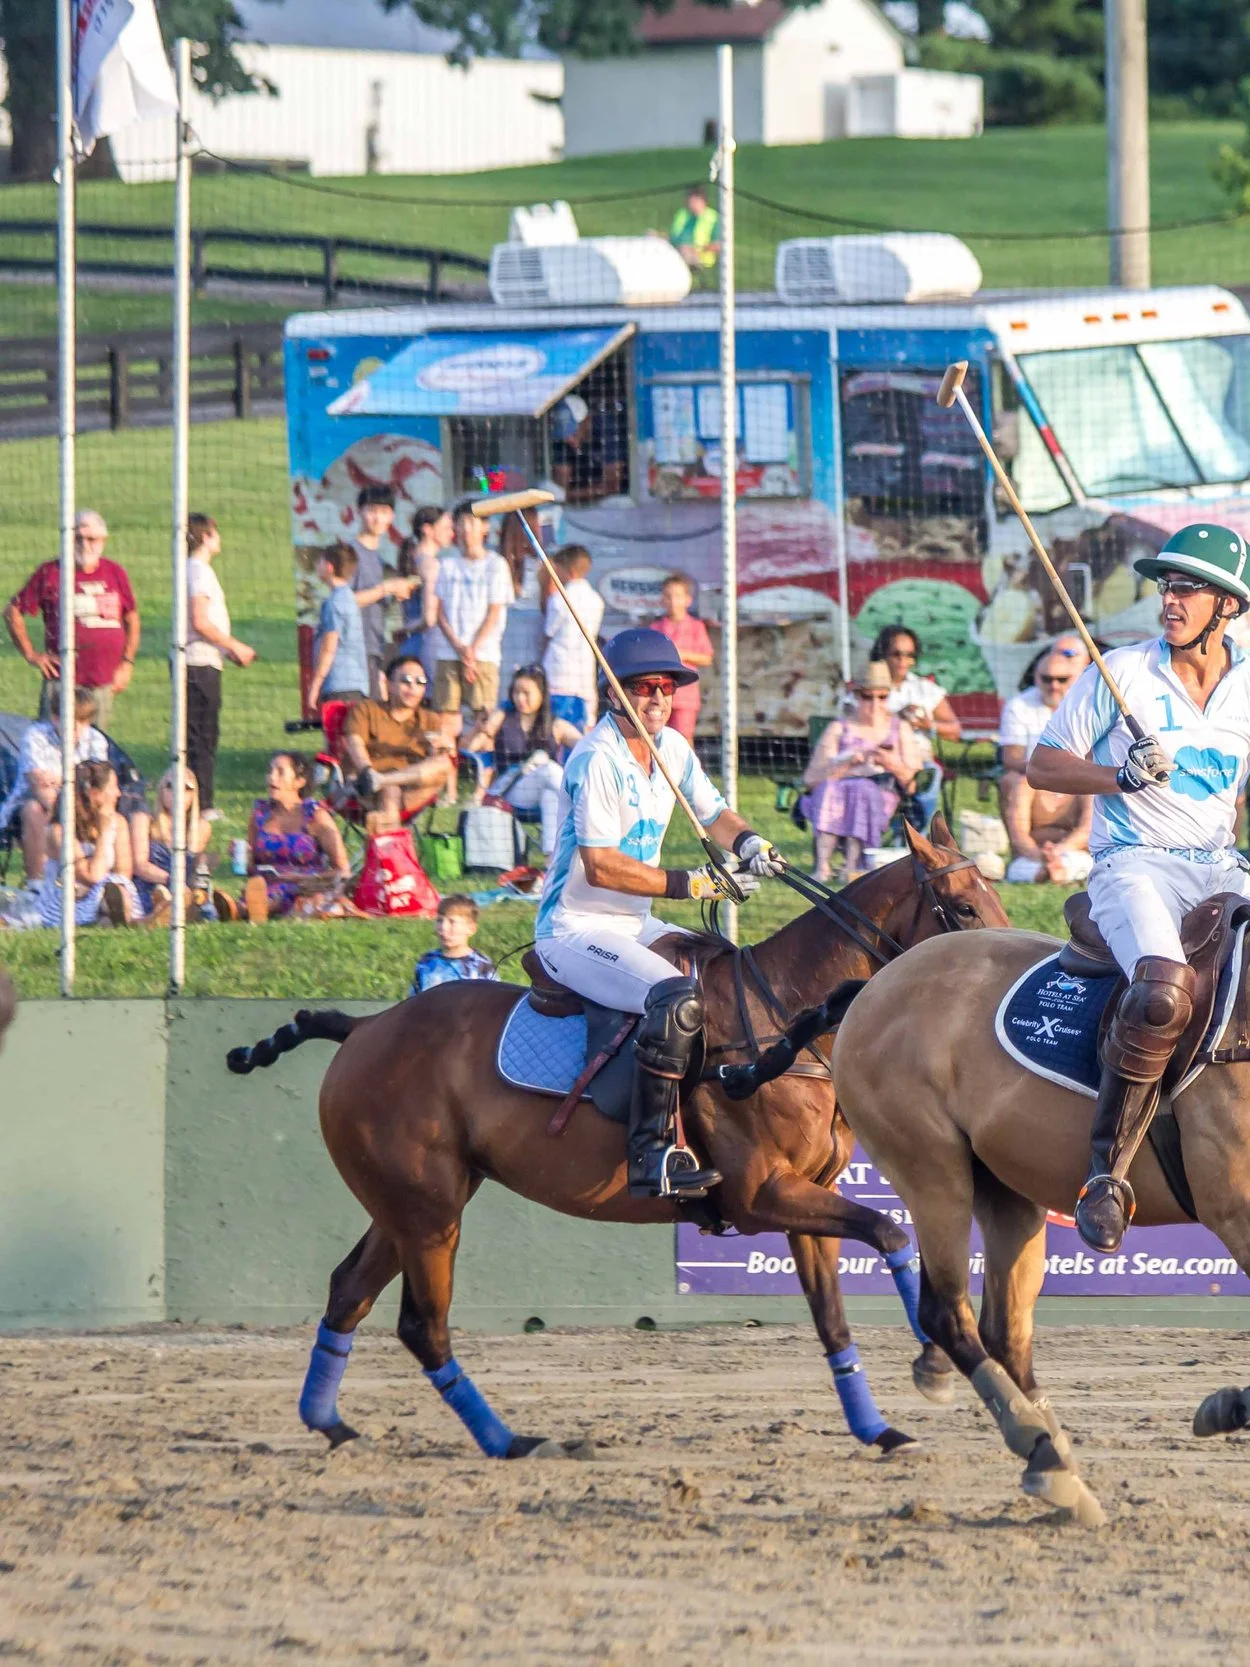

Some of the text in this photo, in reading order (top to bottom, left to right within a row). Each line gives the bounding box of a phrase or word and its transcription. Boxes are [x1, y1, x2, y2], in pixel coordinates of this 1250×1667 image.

[1155, 694, 1183, 731] 1
[586, 944, 620, 963] PRISA
[1037, 989, 1062, 998] HOTELS
[1057, 1003, 1074, 1011] TEAM
[1011, 1017, 1042, 1029] Celebrity
[1054, 1024, 1081, 1036] Cruises
[1043, 1037, 1059, 1046] TEAM
[747, 1251, 798, 1274] Boo
[837, 1256, 879, 1274] our
[1099, 1255, 1127, 1275] at
[1130, 1252, 1239, 1275] Sea.com
